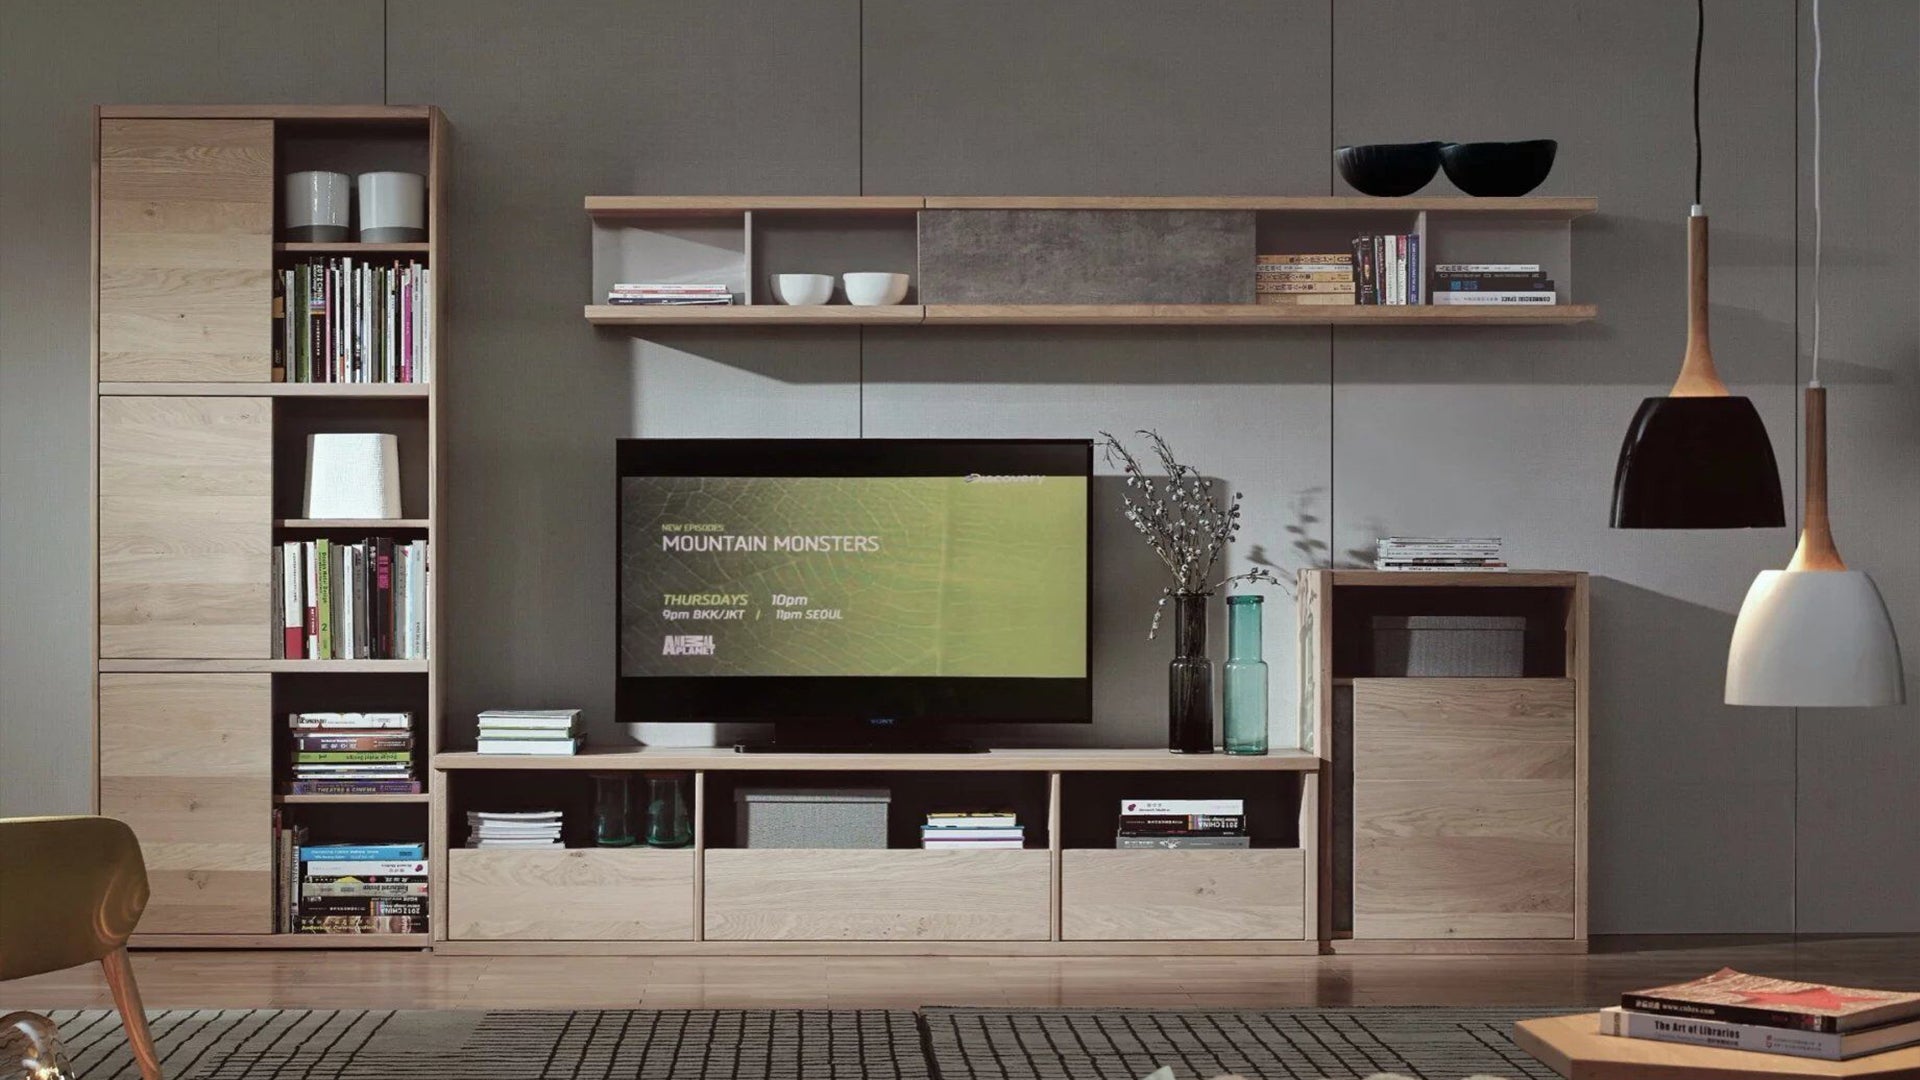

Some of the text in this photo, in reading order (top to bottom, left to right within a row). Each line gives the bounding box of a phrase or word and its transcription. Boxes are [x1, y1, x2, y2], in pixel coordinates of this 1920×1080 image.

[662, 523, 682, 532] NEW
[662, 535, 880, 552] MOUNTAIN MONSTERS
[663, 594, 808, 608] THURSDAYS 10pm
[662, 609, 690, 622] 9pm
[693, 609, 746, 621] BKK/JKT
[775, 609, 803, 622] 11pm
[805, 609, 844, 620] SEOUL
[1655, 1020, 1670, 1031] The
[1673, 1022, 1686, 1033] Art
[1688, 1024, 1697, 1034] of
[1699, 1025, 1740, 1039] Libraries
